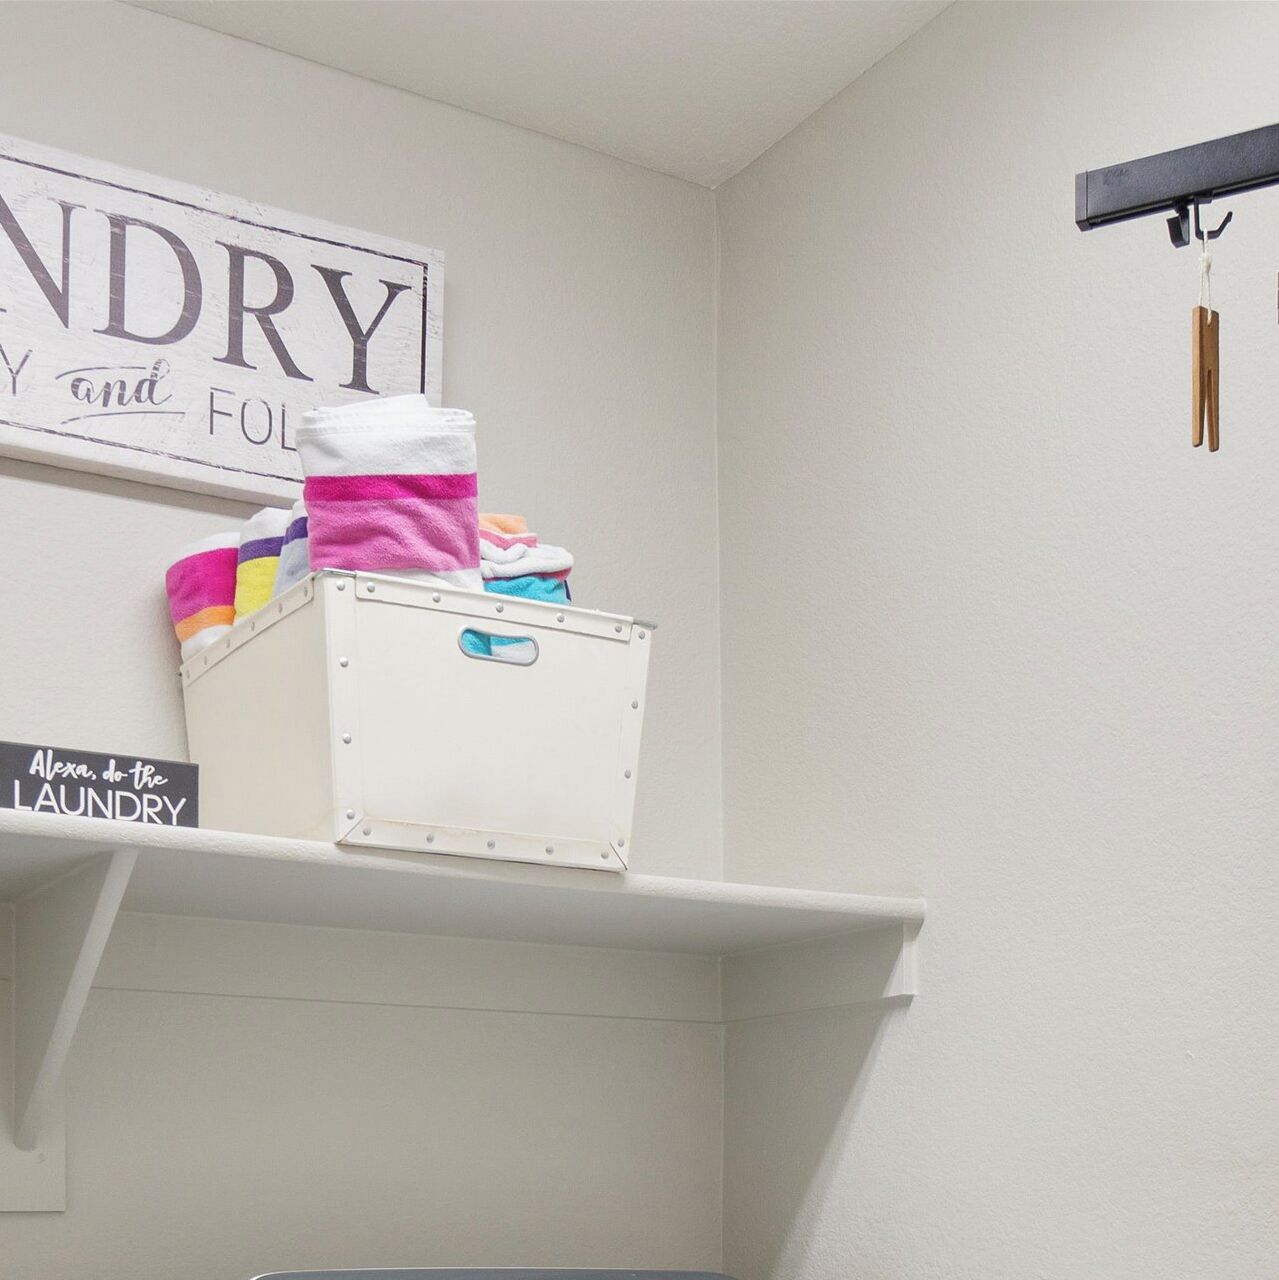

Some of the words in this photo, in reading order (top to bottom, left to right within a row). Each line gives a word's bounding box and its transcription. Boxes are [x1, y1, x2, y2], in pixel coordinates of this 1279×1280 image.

[65, 358, 176, 410] and
[209, 386, 297, 452] FOL
[29, 749, 97, 781] Alexa,
[103, 759, 128, 783] do
[129, 761, 169, 790] the
[13, 779, 188, 826] LAUNDRY
